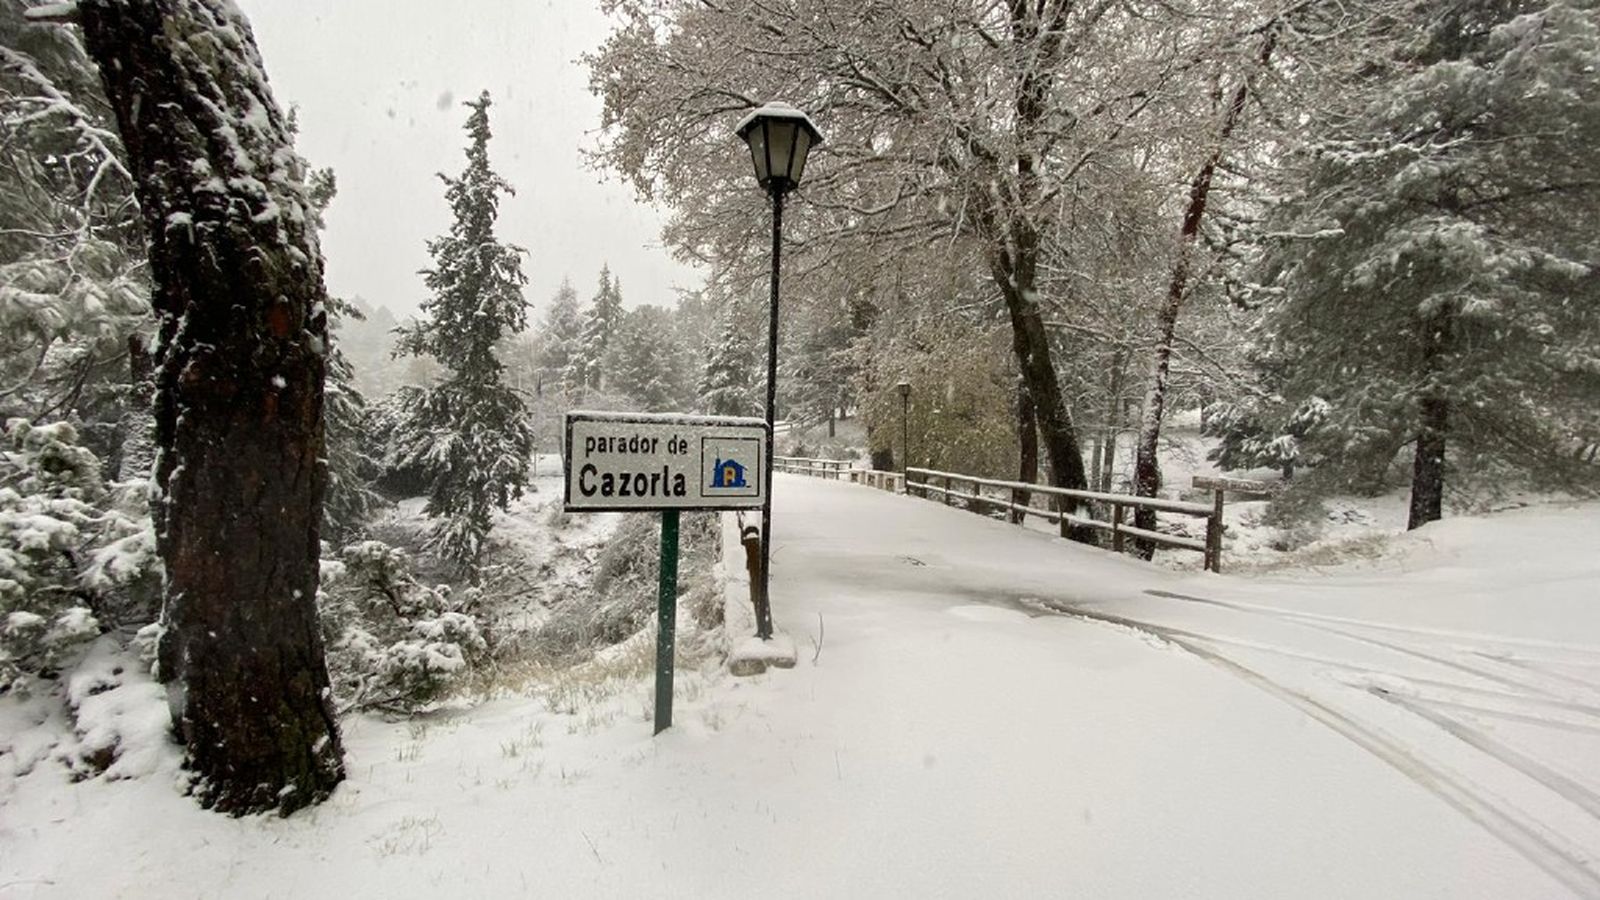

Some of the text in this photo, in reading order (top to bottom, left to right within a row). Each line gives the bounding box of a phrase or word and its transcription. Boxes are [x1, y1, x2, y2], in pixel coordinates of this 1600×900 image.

[585, 434, 688, 457] parador de
[579, 463, 687, 497] Cazorla
